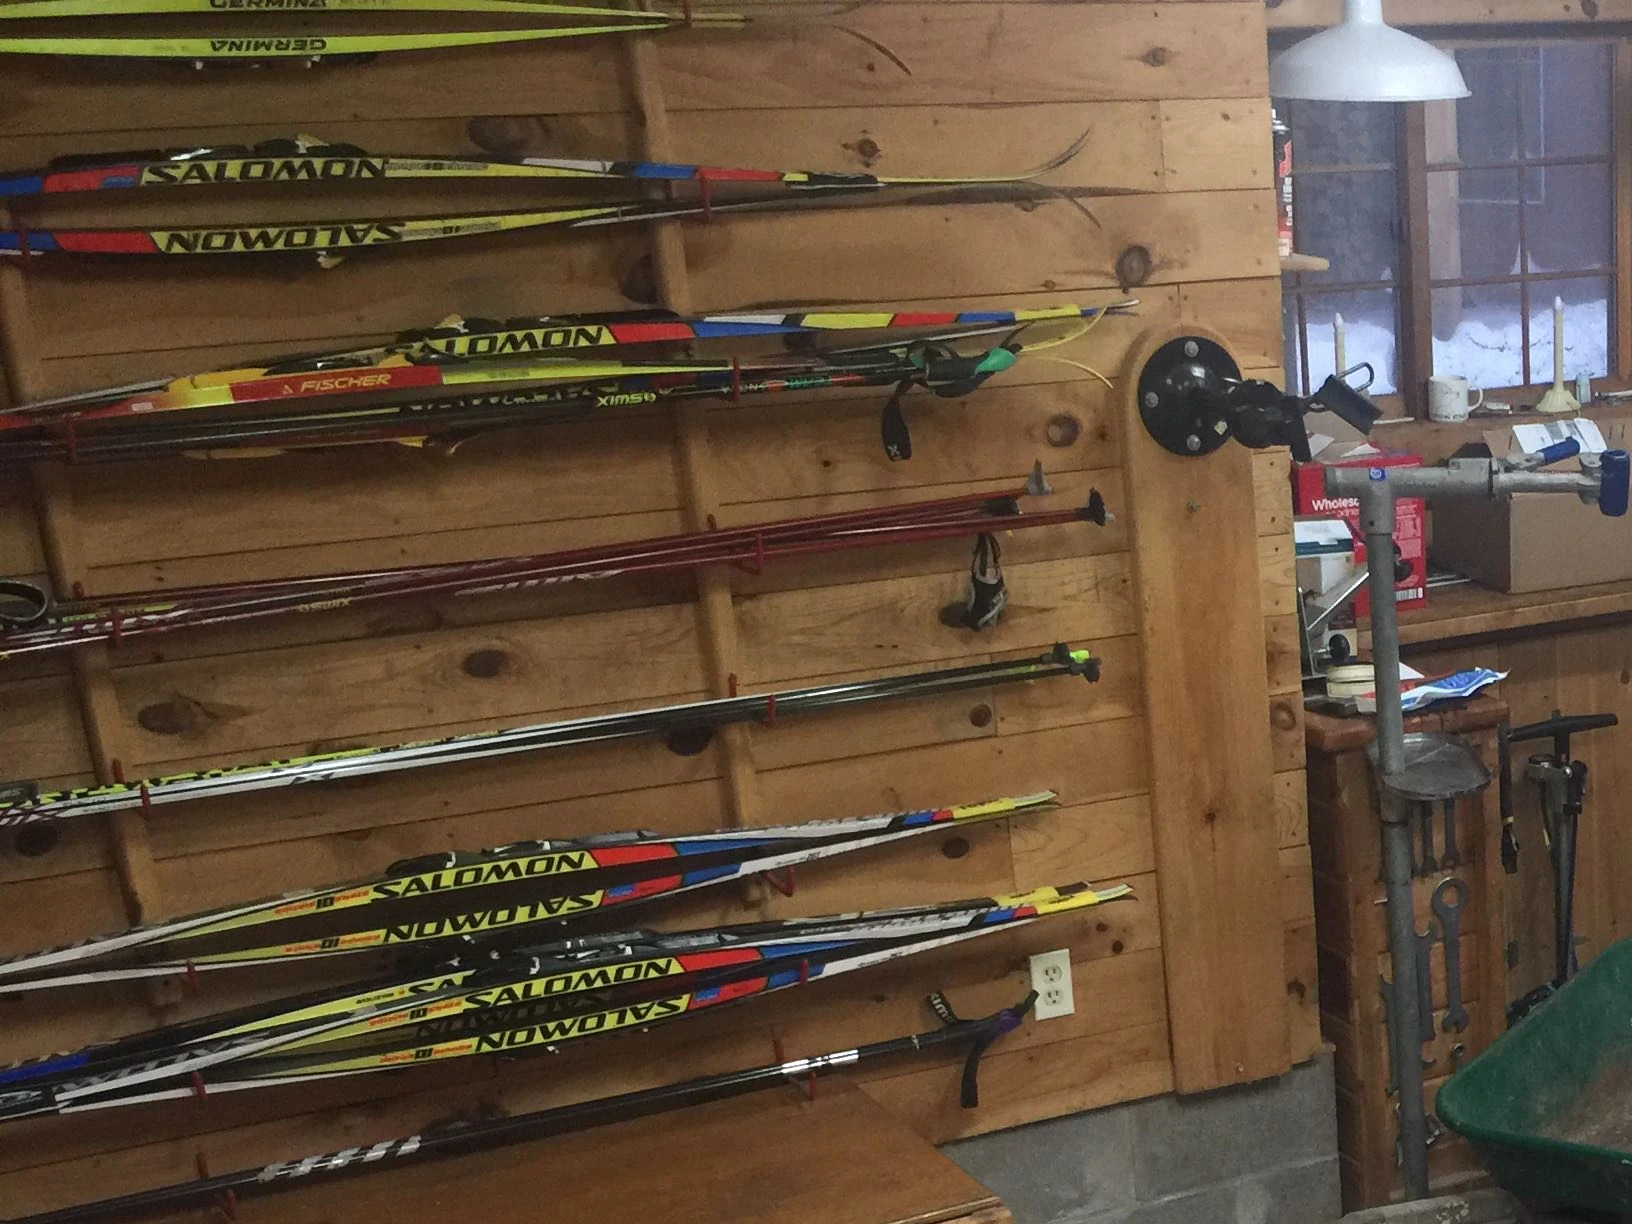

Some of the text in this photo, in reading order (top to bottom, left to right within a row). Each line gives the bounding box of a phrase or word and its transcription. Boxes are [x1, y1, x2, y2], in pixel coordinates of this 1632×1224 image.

[210, 39, 327, 52] GERMINA
[145, 158, 388, 184] SALOMON
[165, 222, 405, 252] SALOMON
[300, 373, 392, 393] FISCHER
[371, 852, 586, 900] SALOMON
[384, 894, 596, 943] SALOMON
[463, 958, 672, 1012] SALOMON
[475, 996, 684, 1051] SALOMON
